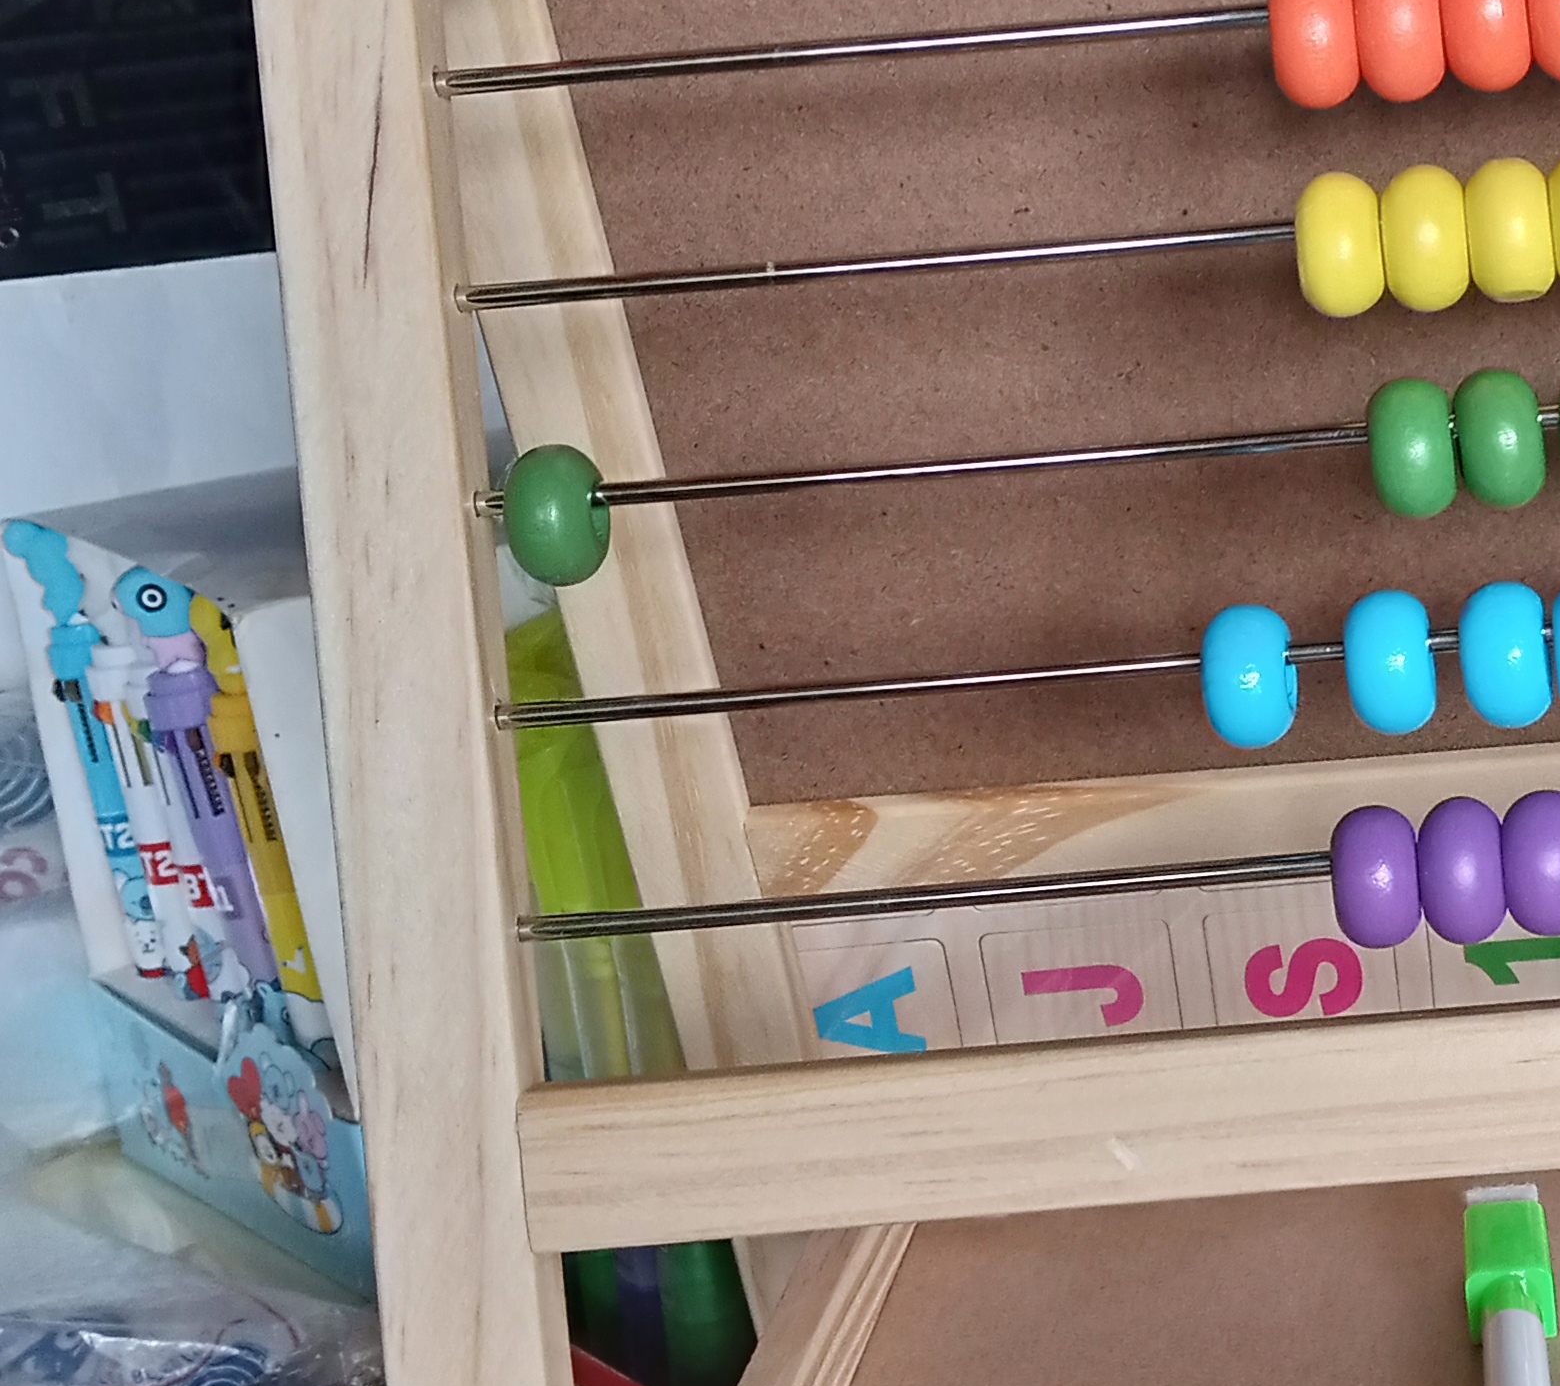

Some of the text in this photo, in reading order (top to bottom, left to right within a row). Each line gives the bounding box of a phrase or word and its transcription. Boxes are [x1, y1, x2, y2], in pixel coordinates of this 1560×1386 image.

[813, 966, 927, 1053] A
[1021, 964, 1144, 1027] J
[1244, 937, 1364, 1018] S
